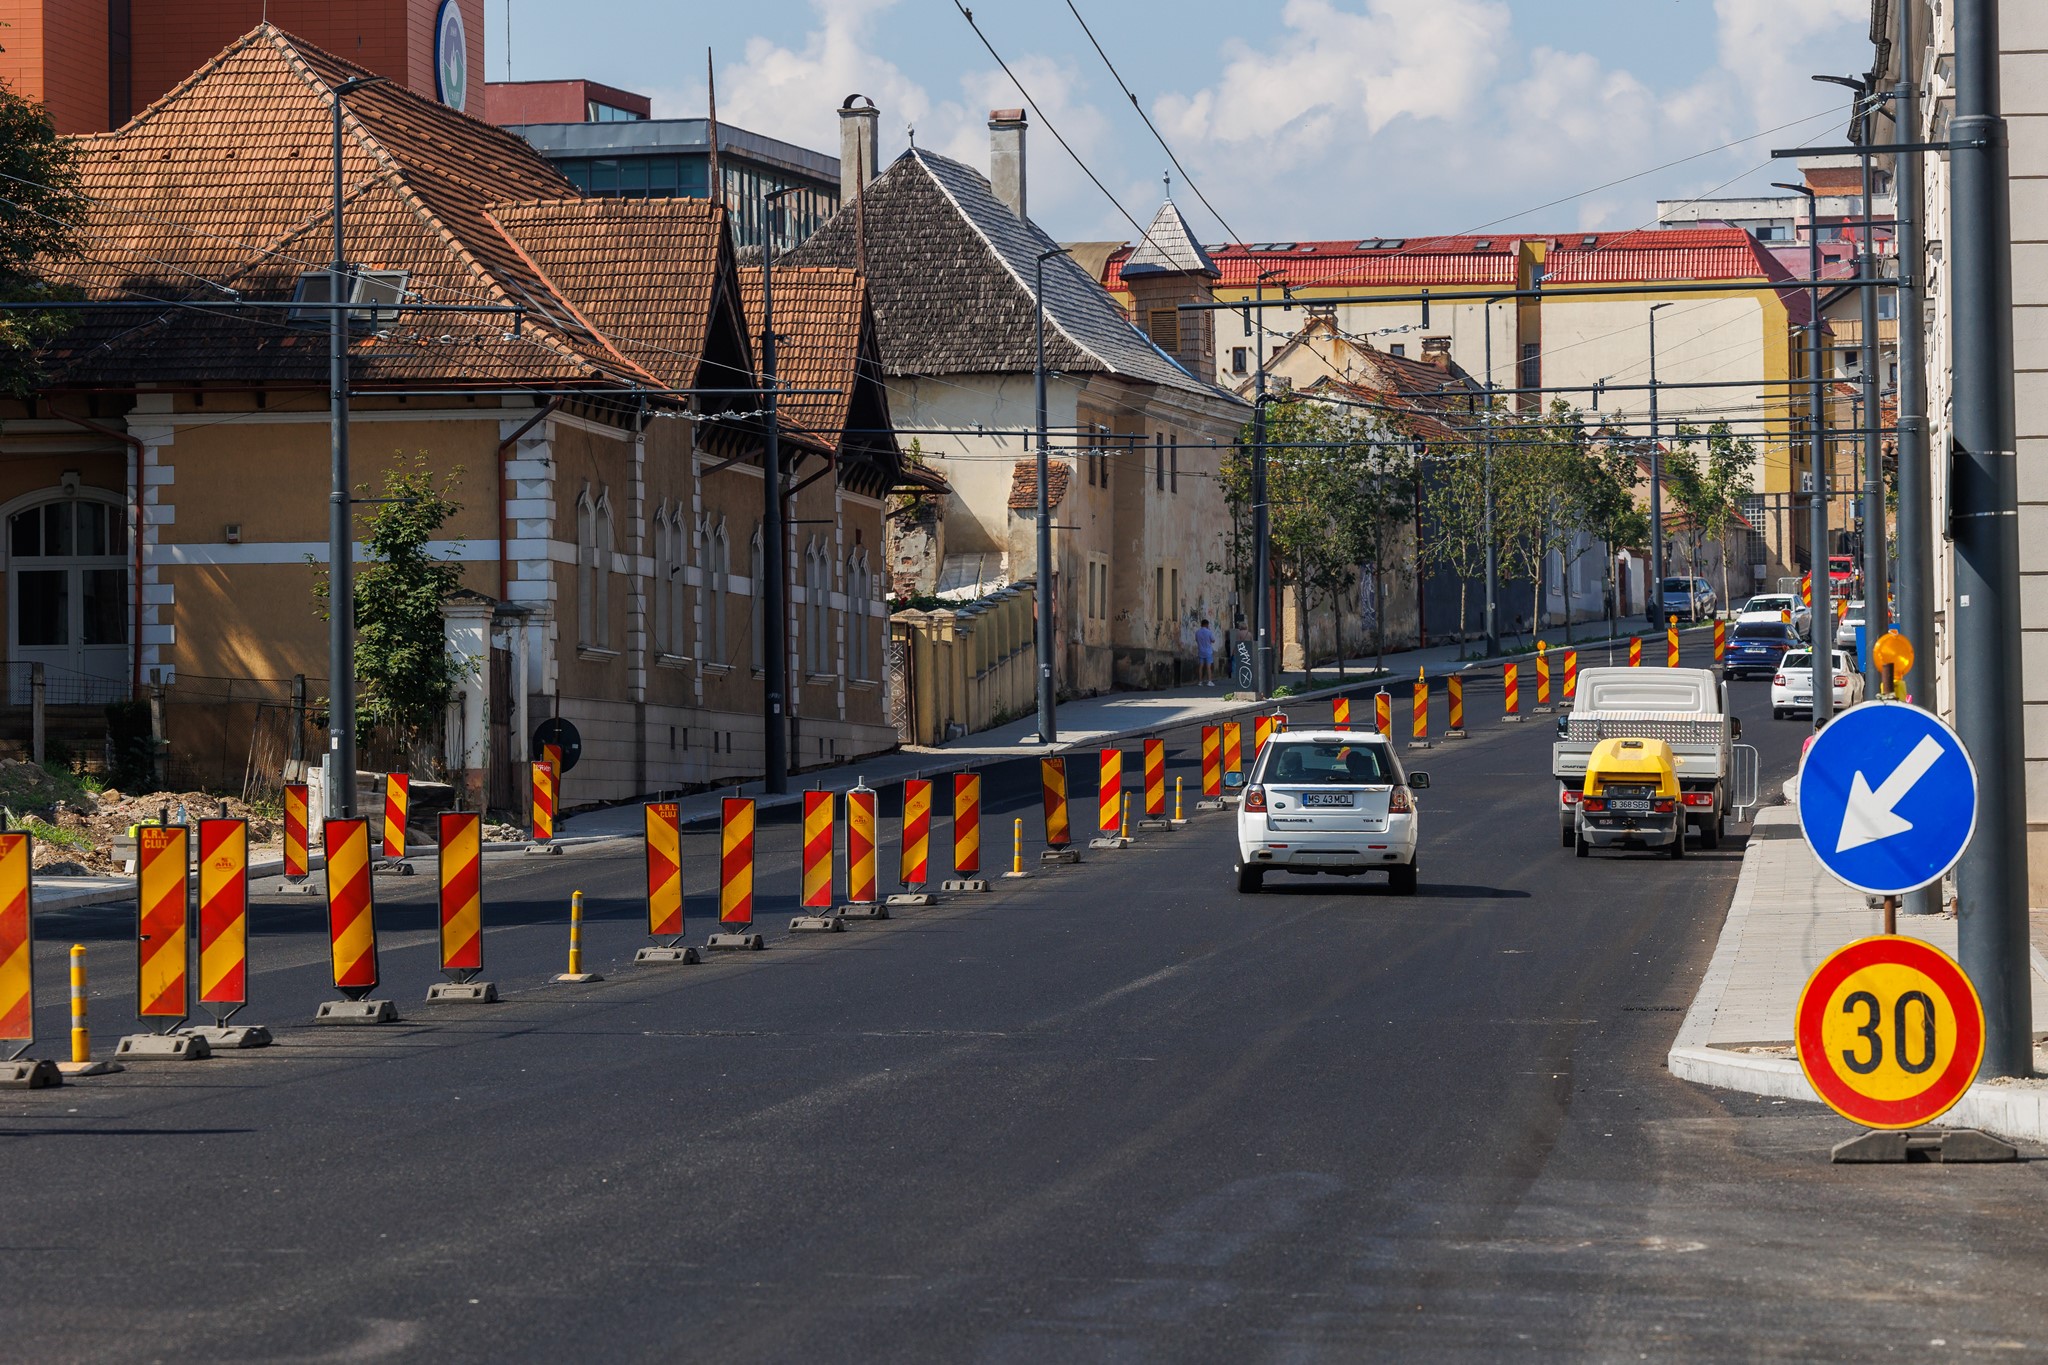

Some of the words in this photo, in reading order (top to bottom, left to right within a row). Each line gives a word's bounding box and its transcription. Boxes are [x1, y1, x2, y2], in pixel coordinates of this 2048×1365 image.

[1308, 795, 1320, 804] MS
[1322, 795, 1333, 804] 43
[1334, 795, 1352, 804] MDL
[1611, 801, 1617, 809] B
[1619, 801, 1632, 809] 368
[1632, 801, 1649, 809] SBG
[144, 840, 167, 849] CLUJ
[1842, 990, 1936, 1075] 30
